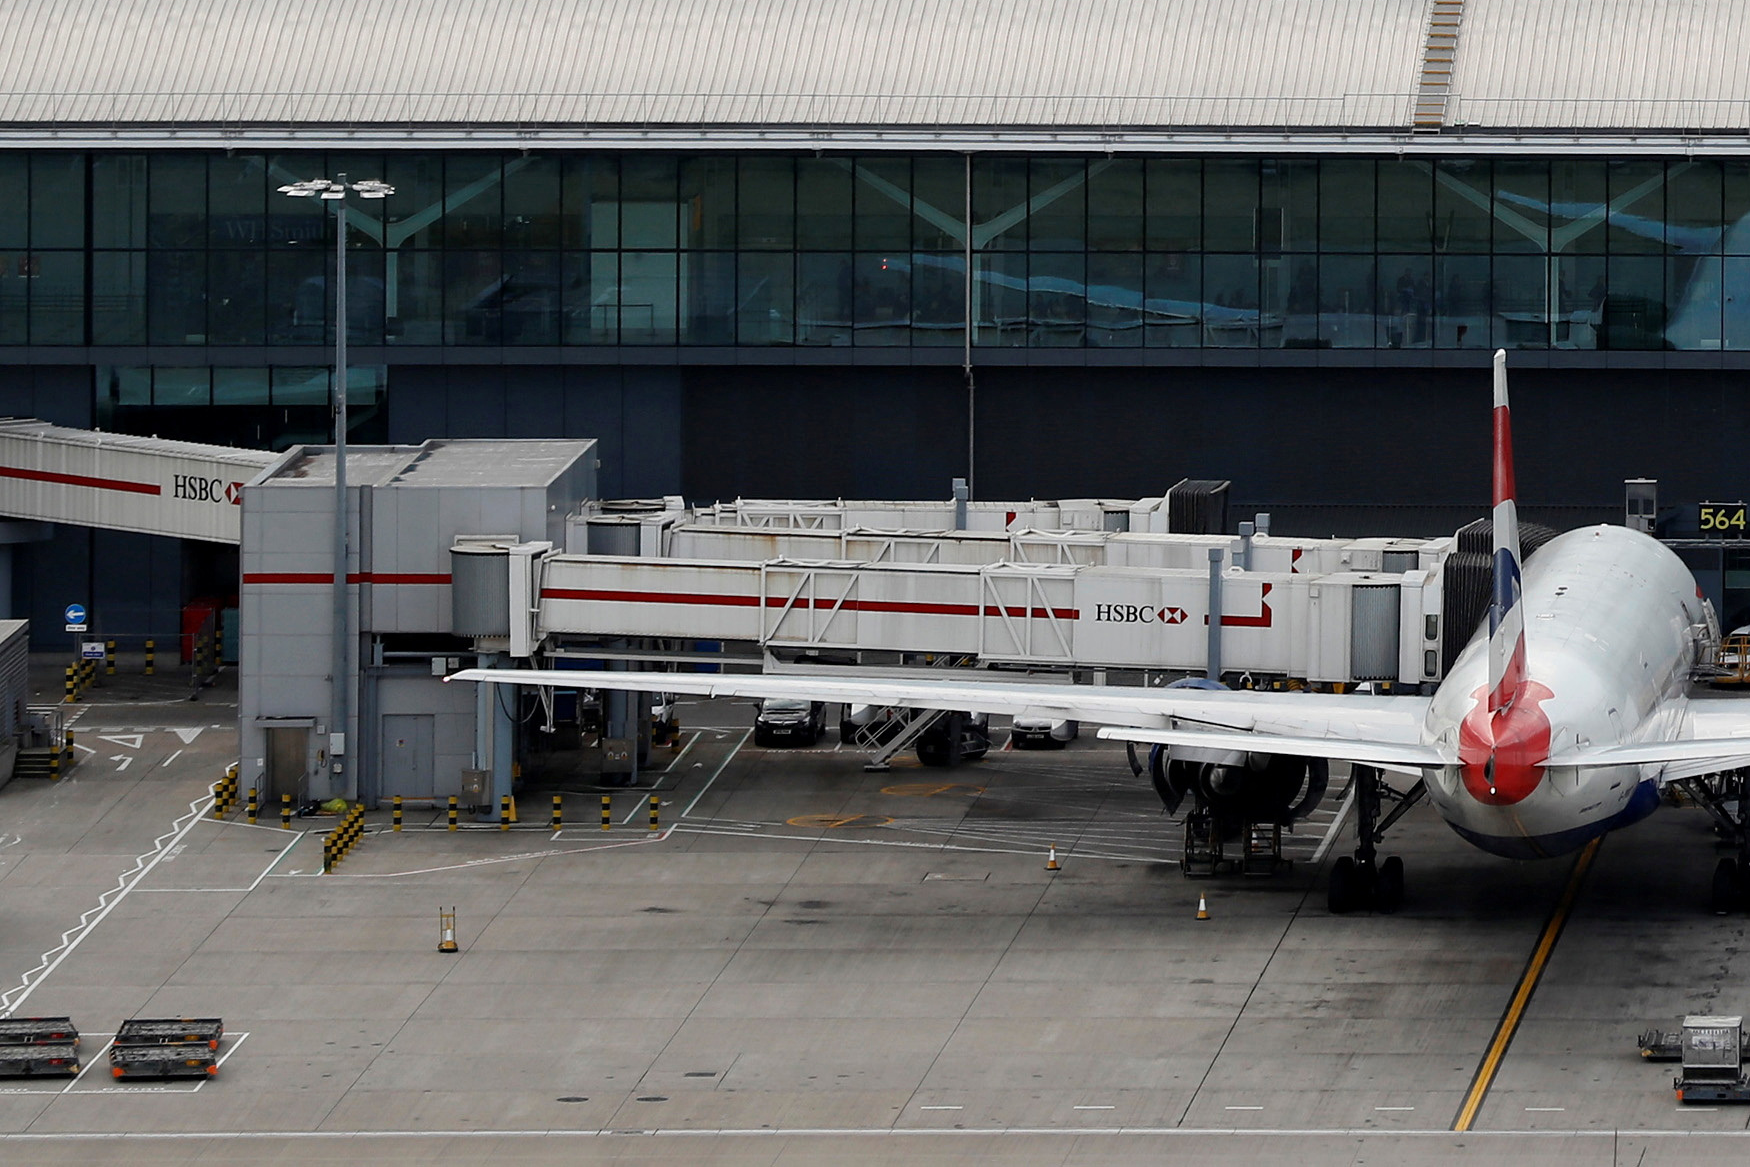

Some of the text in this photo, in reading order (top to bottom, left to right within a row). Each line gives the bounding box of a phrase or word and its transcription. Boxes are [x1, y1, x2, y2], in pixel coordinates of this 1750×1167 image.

[173, 474, 223, 503] HSBC
[1700, 508, 1746, 530] 564
[1095, 603, 1155, 624] HSBC
